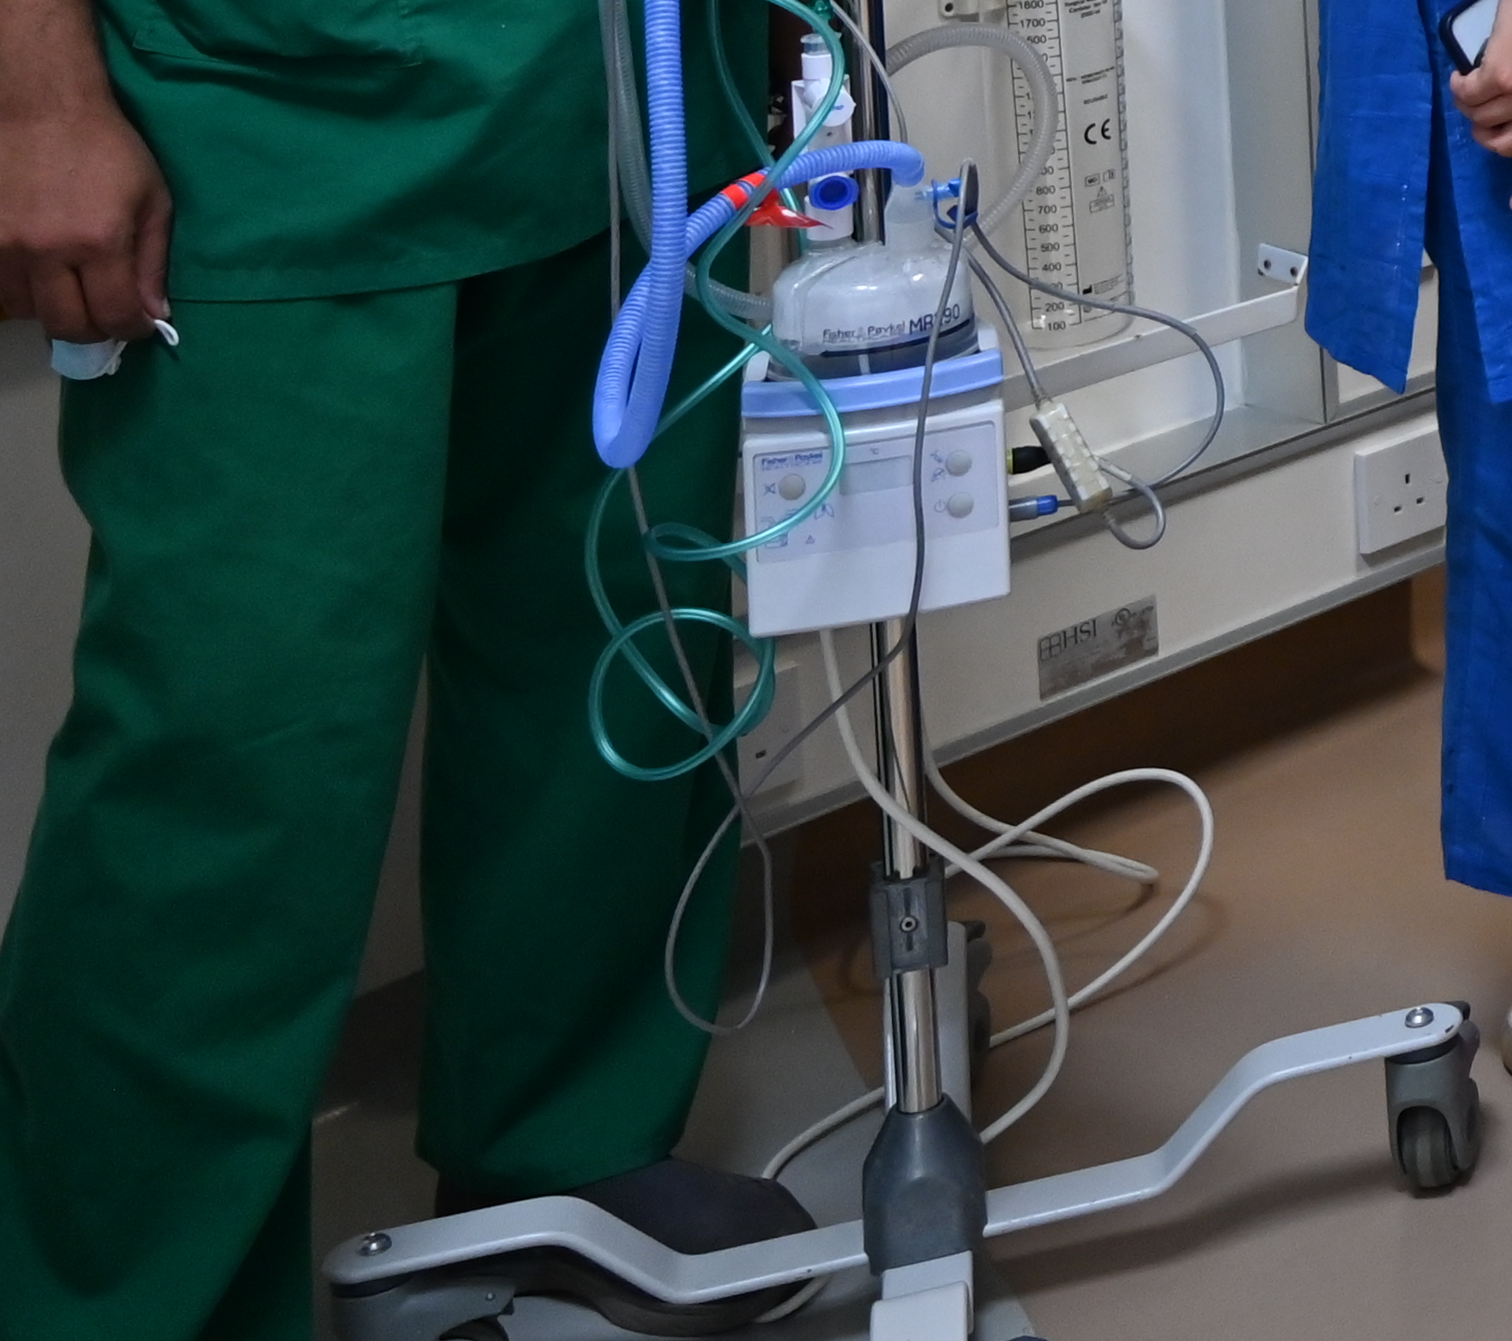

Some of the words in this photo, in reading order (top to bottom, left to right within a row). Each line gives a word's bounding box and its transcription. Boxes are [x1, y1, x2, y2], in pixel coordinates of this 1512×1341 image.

[1019, 0, 1045, 10] 1800
[1019, 18, 1046, 28] 1700
[1084, 118, 1112, 145] CE
[1036, 185, 1056, 195] 800
[1038, 205, 1057, 214] 700
[1039, 223, 1059, 233] 600
[1040, 243, 1060, 252] 500
[1042, 262, 1062, 271] 400
[1045, 302, 1065, 312] 200
[1048, 321, 1066, 331] 100
[823, 328, 855, 339] Fisher
[1062, 619, 1097, 649] HSI
